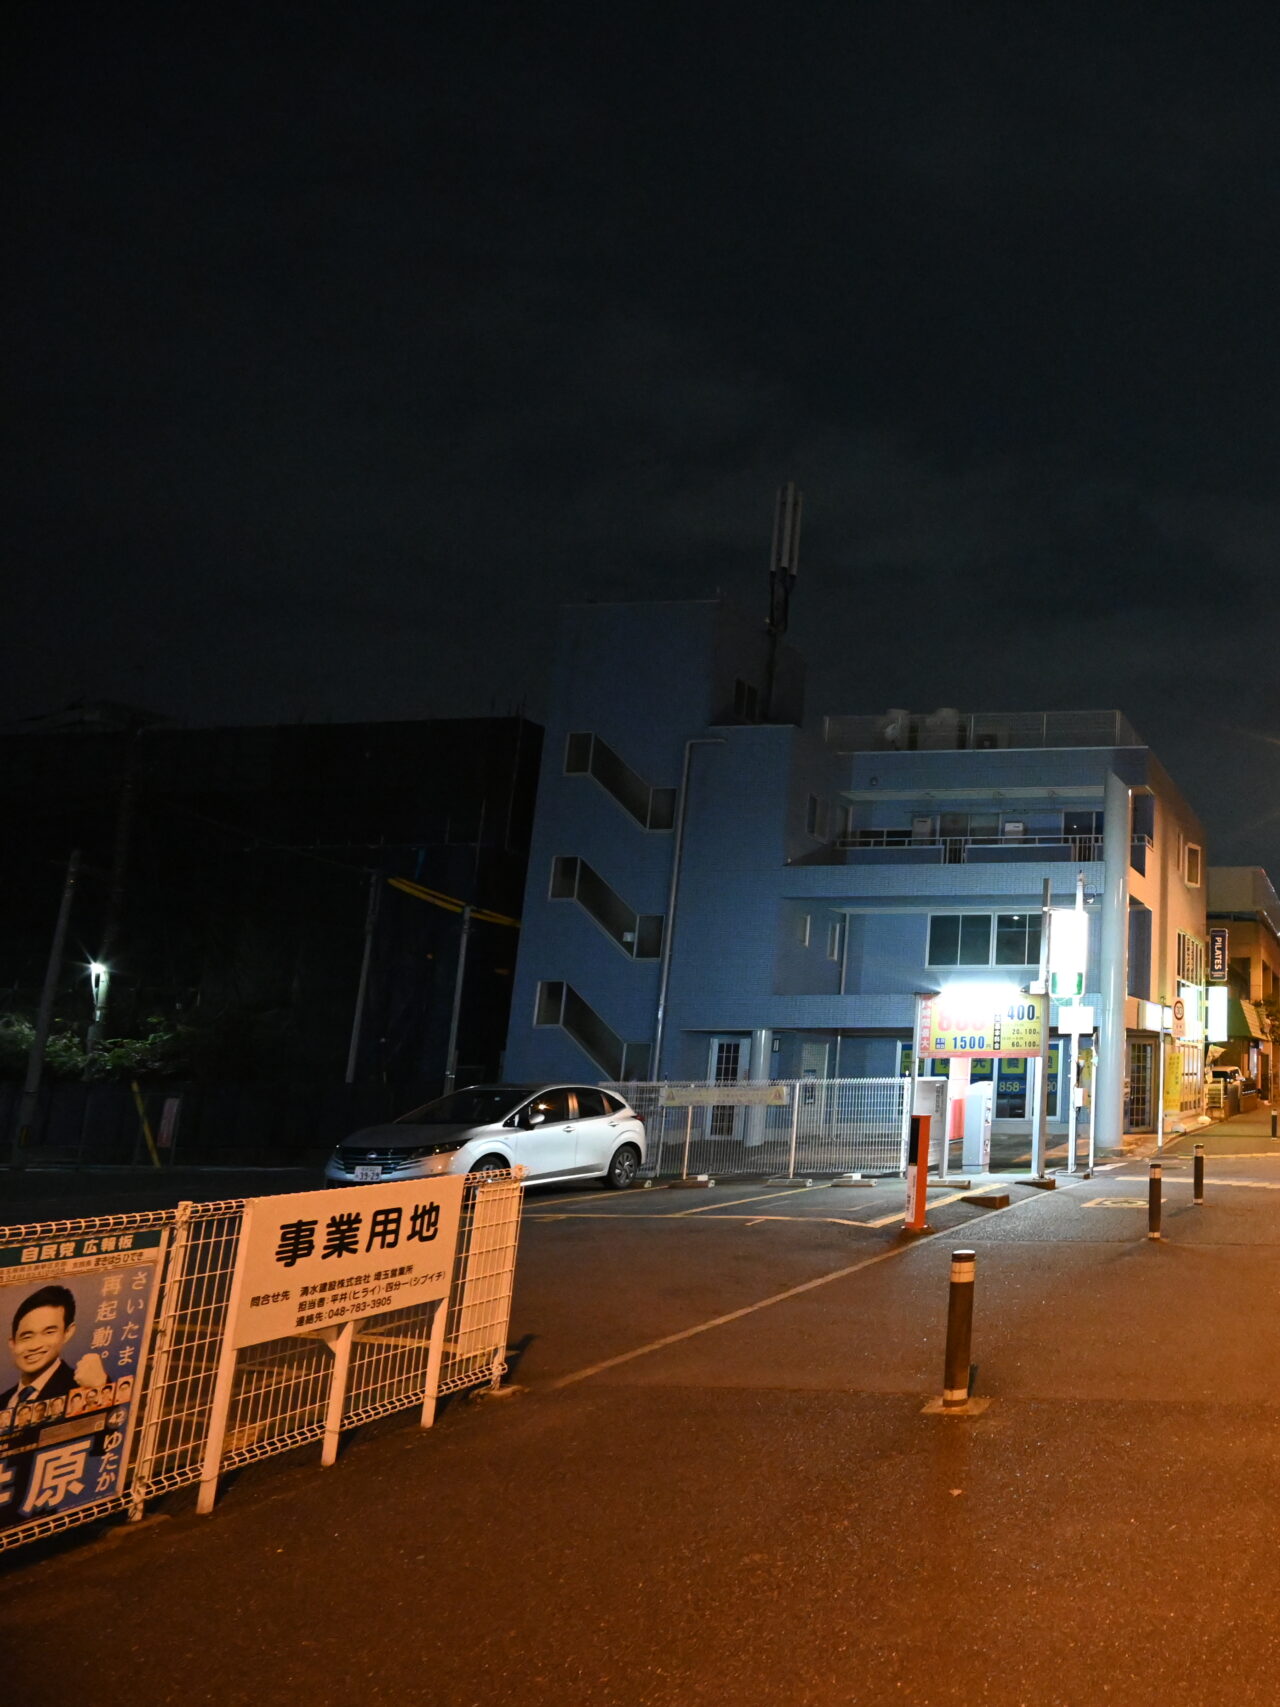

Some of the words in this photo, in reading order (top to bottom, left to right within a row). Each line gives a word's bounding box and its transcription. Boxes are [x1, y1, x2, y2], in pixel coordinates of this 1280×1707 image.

[1214, 937, 1223, 970] PILATES
[20, 1243, 75, 1264] 自民党
[82, 1234, 135, 1256] 広報板
[275, 1201, 441, 1267] 事業用地
[250, 1290, 291, 1308] 問合せ先
[373, 1264, 414, 1282] 埼玉営業所
[117, 1271, 149, 1366] さいたま
[0, 1439, 92, 1513] 原
[95, 1431, 123, 1492] ゆたか
